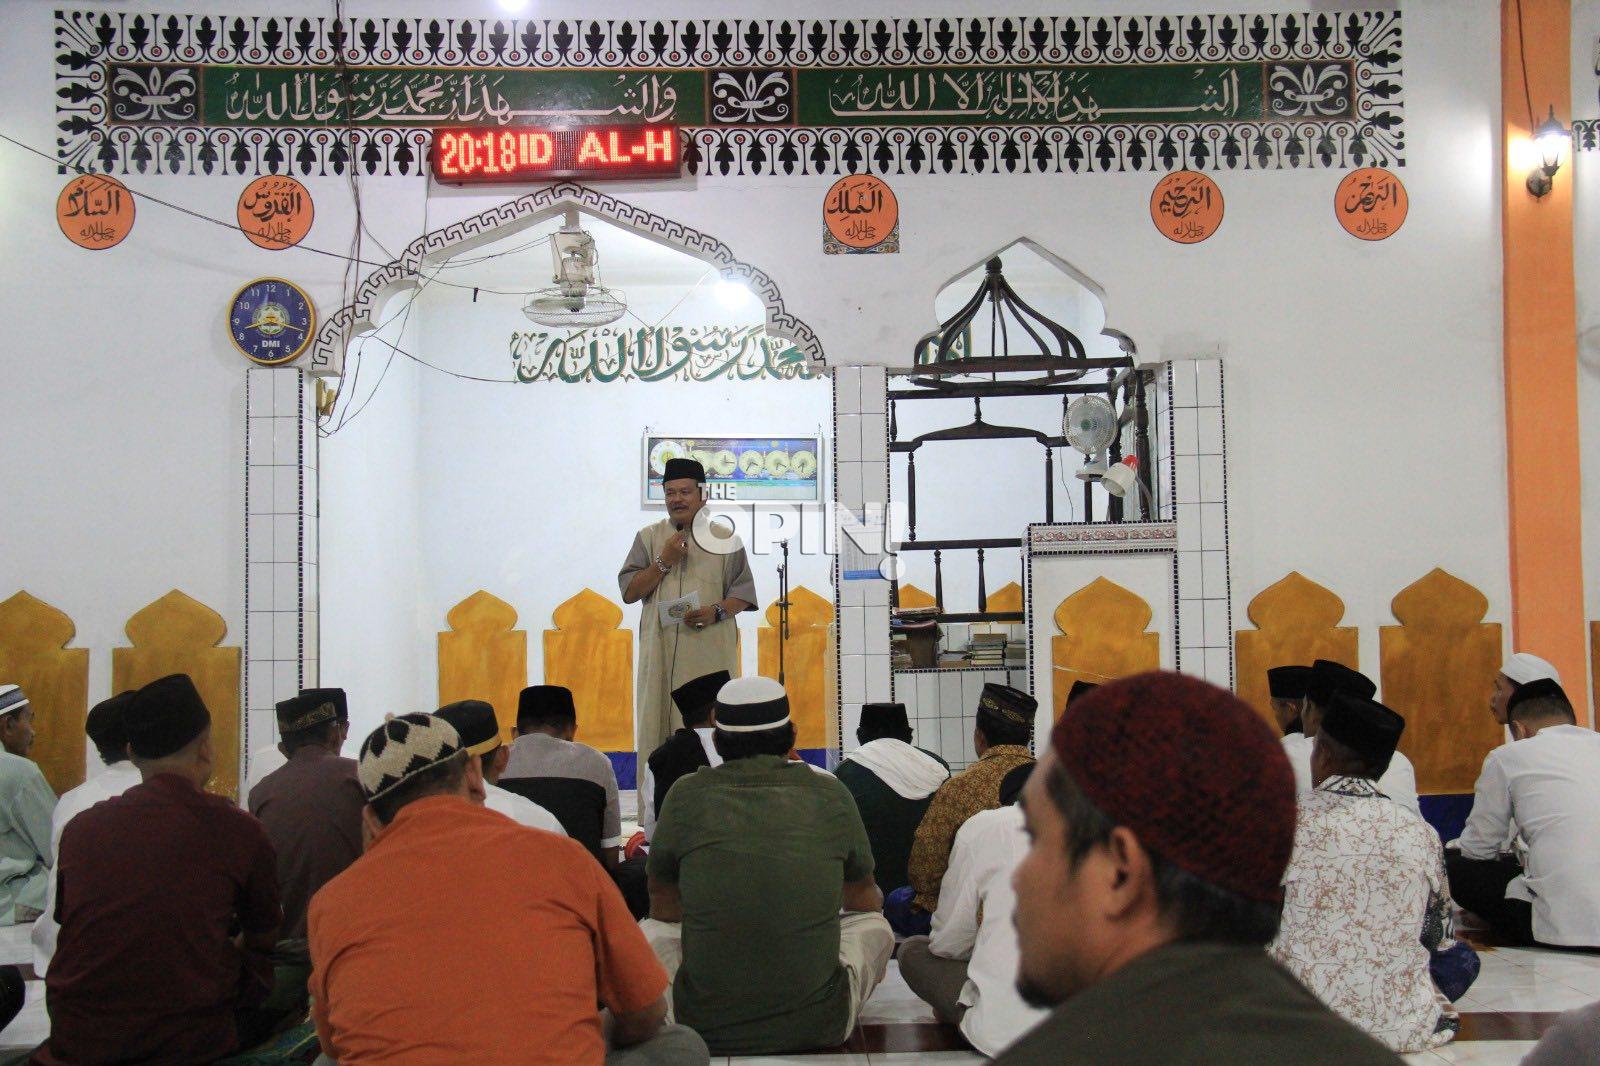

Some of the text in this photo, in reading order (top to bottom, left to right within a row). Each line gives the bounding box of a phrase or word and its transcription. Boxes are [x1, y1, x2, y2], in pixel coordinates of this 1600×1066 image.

[519, 130, 672, 164] ID AL-H
[441, 132, 517, 174] 20:18
[251, 289, 260, 297] 11
[266, 285, 276, 293] 12
[286, 289, 290, 297] 1
[240, 302, 250, 310] 10
[302, 318, 307, 326] 3
[261, 340, 280, 348] DMI
[285, 345, 291, 353] 5
